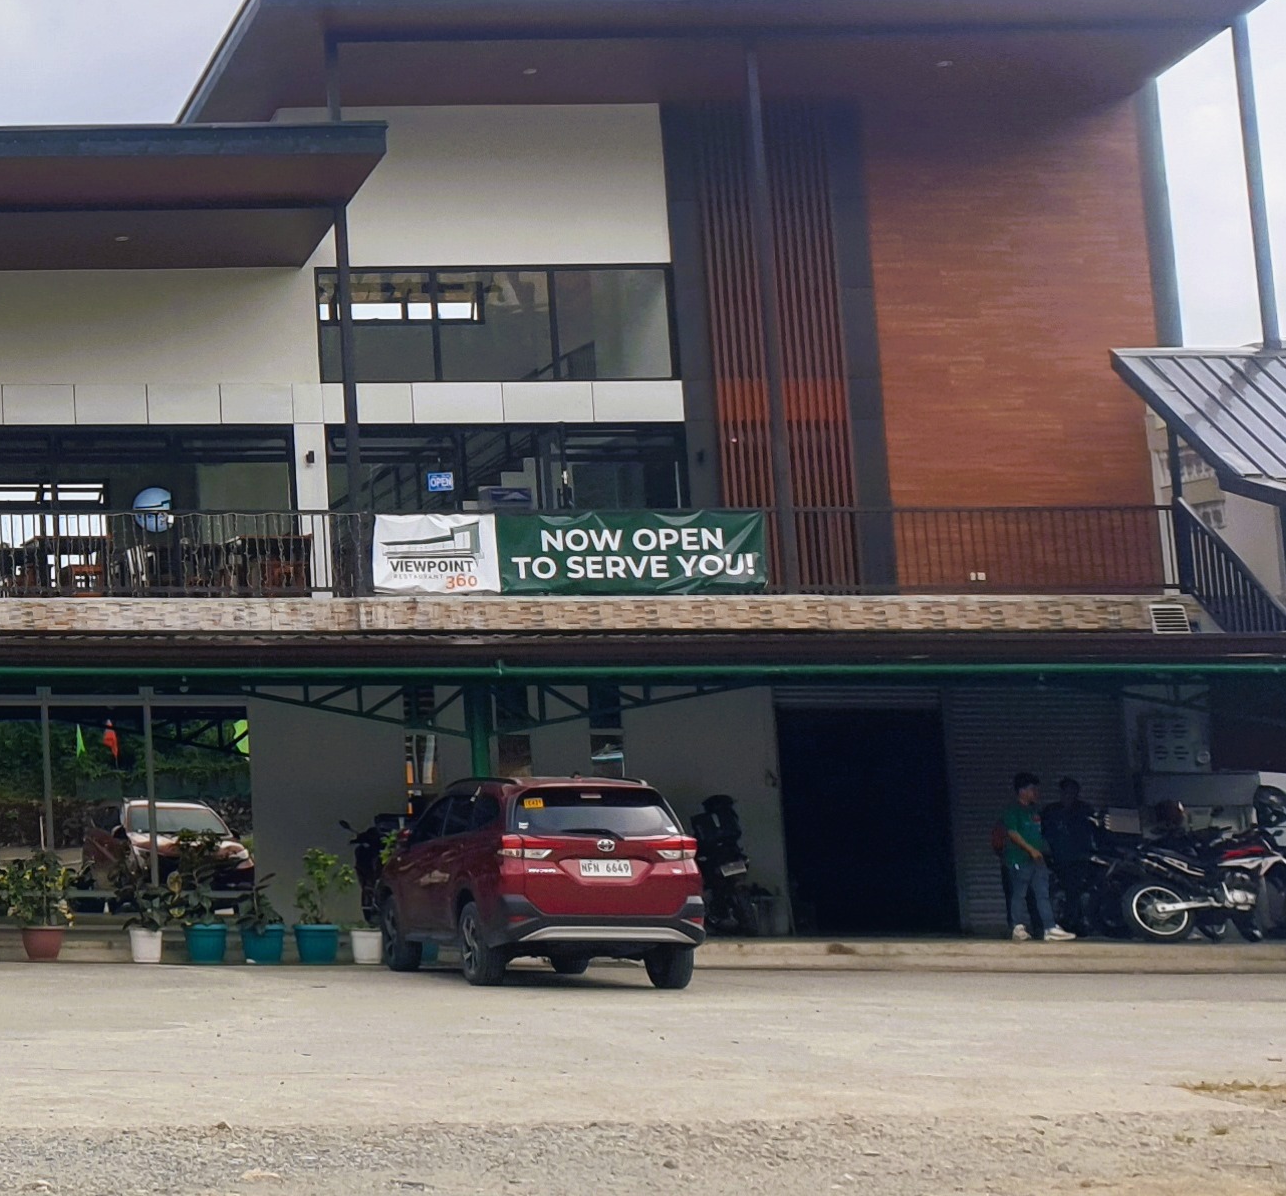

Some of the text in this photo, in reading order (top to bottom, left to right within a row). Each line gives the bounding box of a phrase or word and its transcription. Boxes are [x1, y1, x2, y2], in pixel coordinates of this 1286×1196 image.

[430, 476, 453, 488] OPEN
[540, 528, 724, 552] NOW OPEN
[389, 559, 474, 573] VIEWPOINT
[511, 553, 756, 579] TO SERVE YOU!
[393, 573, 444, 581] RESTAURANT
[445, 573, 478, 590] 360
[581, 863, 630, 873] NFN 6649
